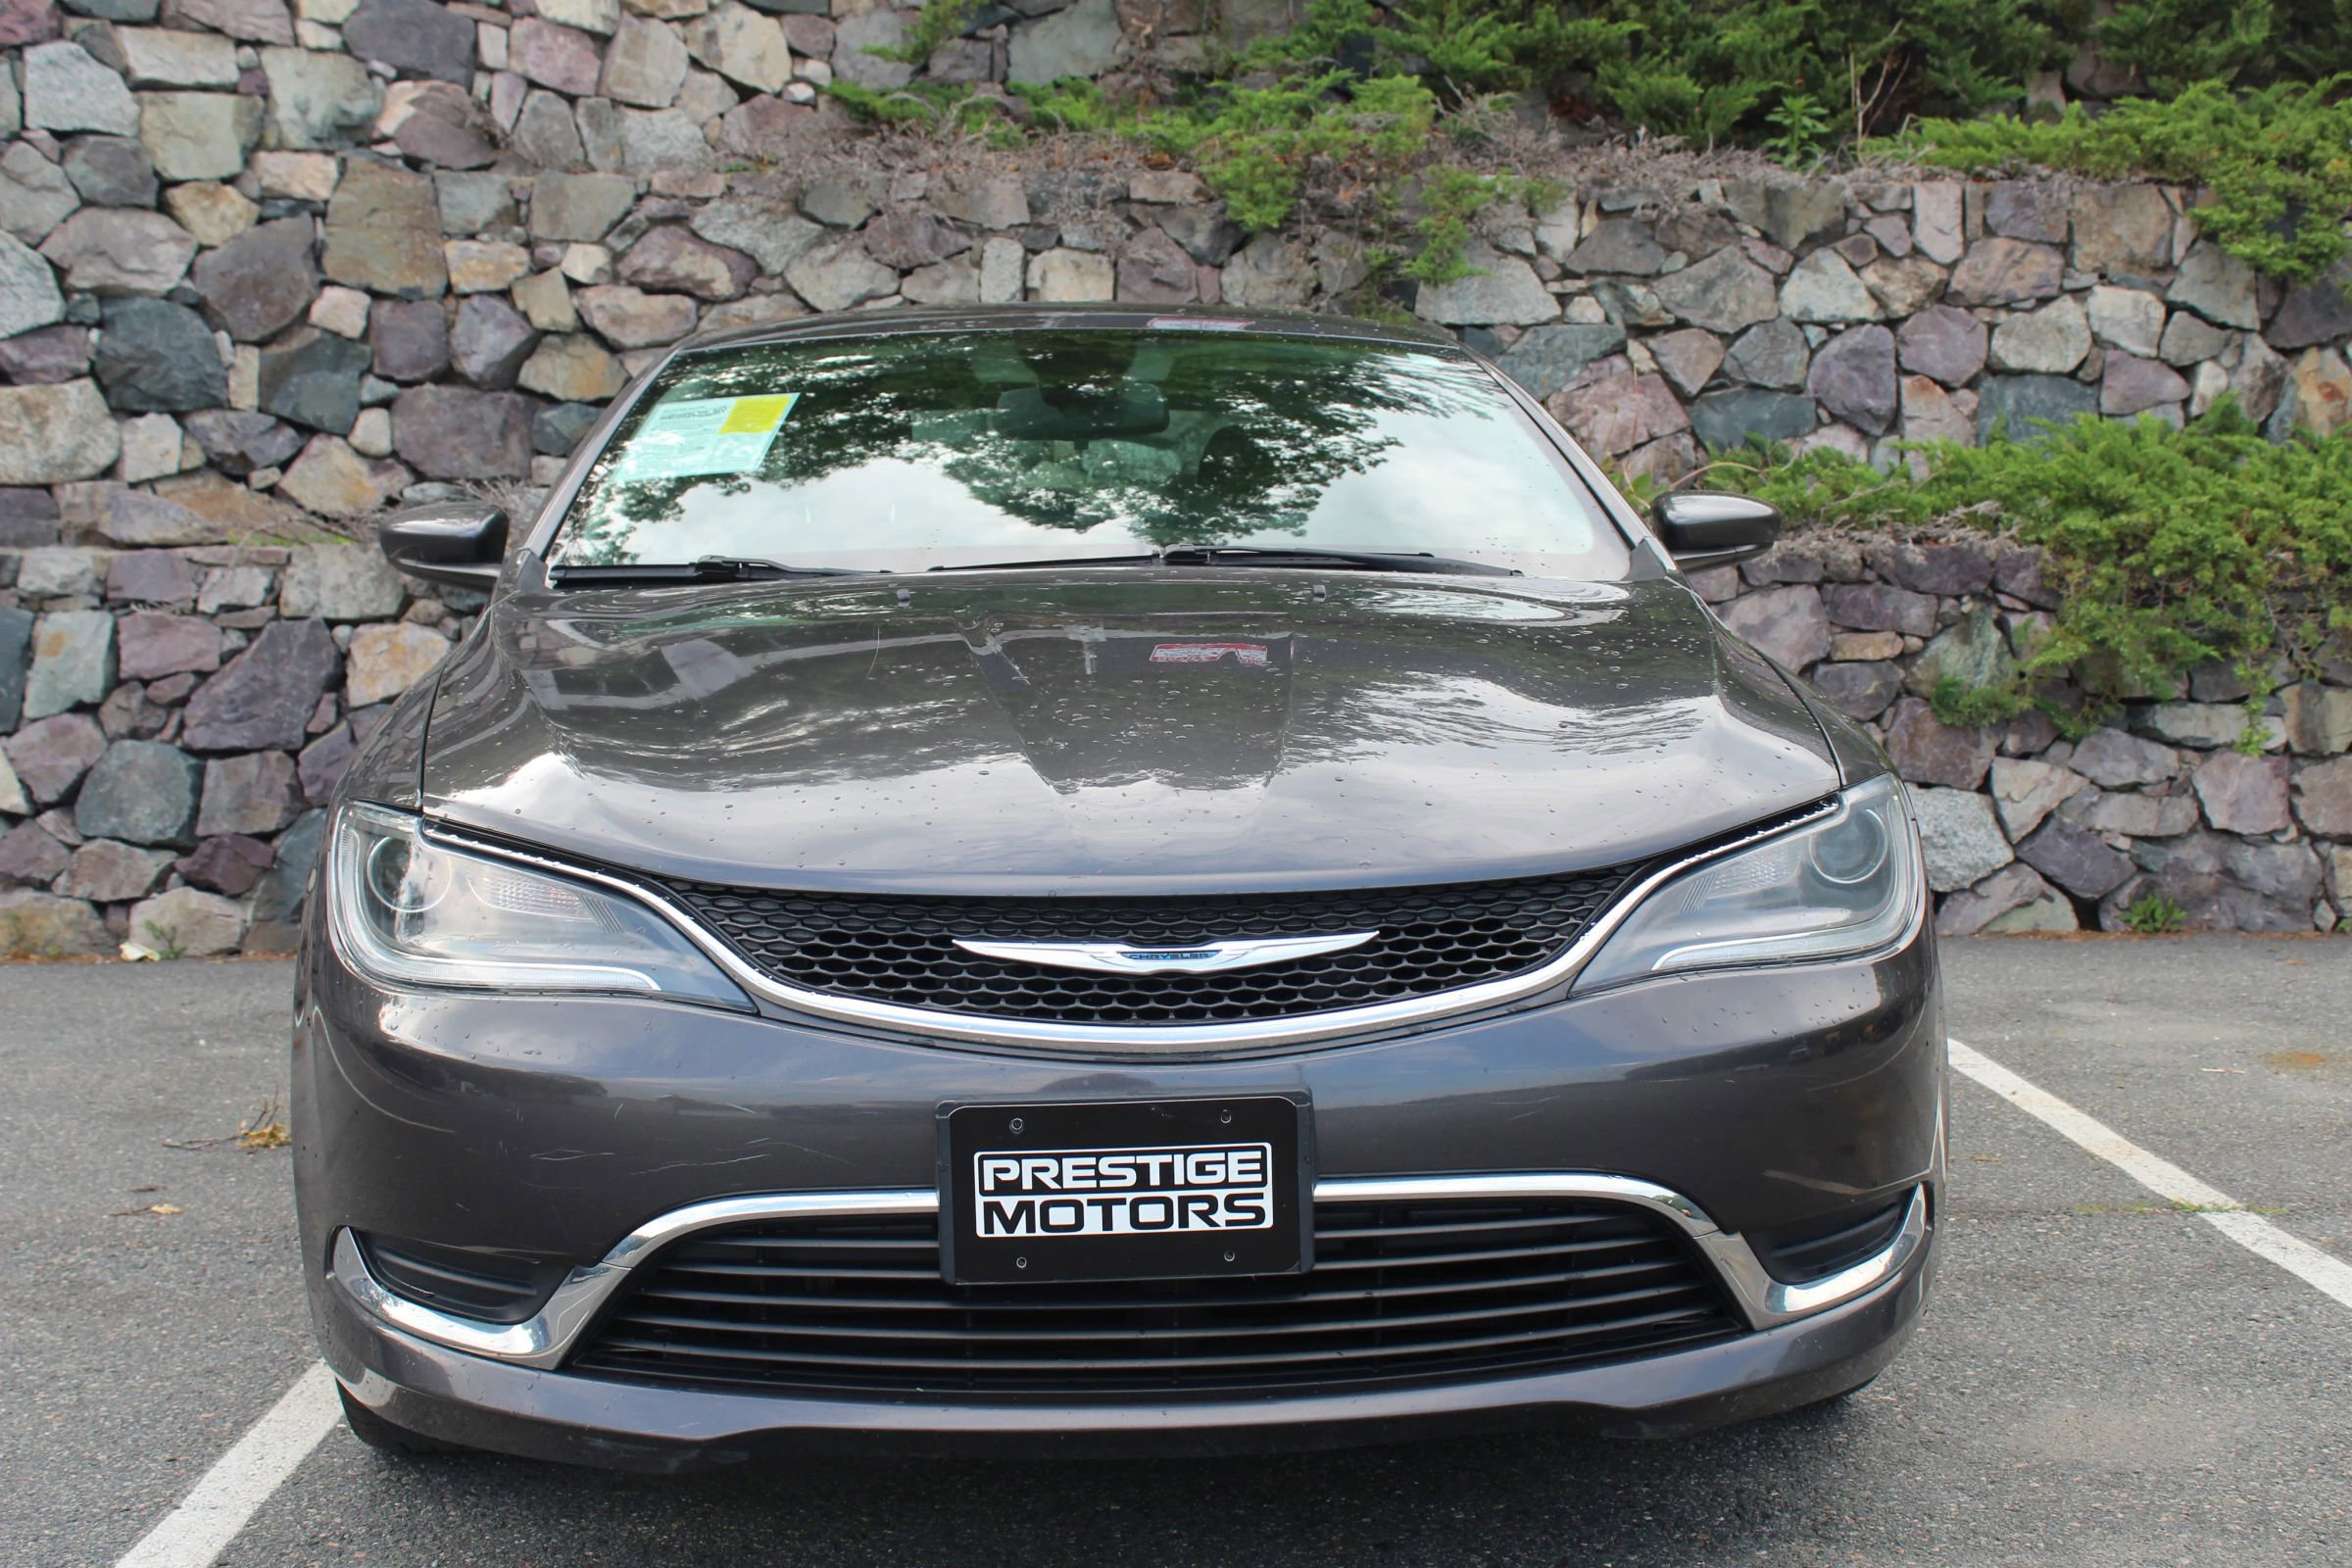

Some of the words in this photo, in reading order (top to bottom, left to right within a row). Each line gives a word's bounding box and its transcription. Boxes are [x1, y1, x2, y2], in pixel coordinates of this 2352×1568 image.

[1128, 952, 1209, 960] CHRYSLER
[983, 1151, 1262, 1191] PRESTIGE
[984, 1193, 1266, 1235] MOTORS
